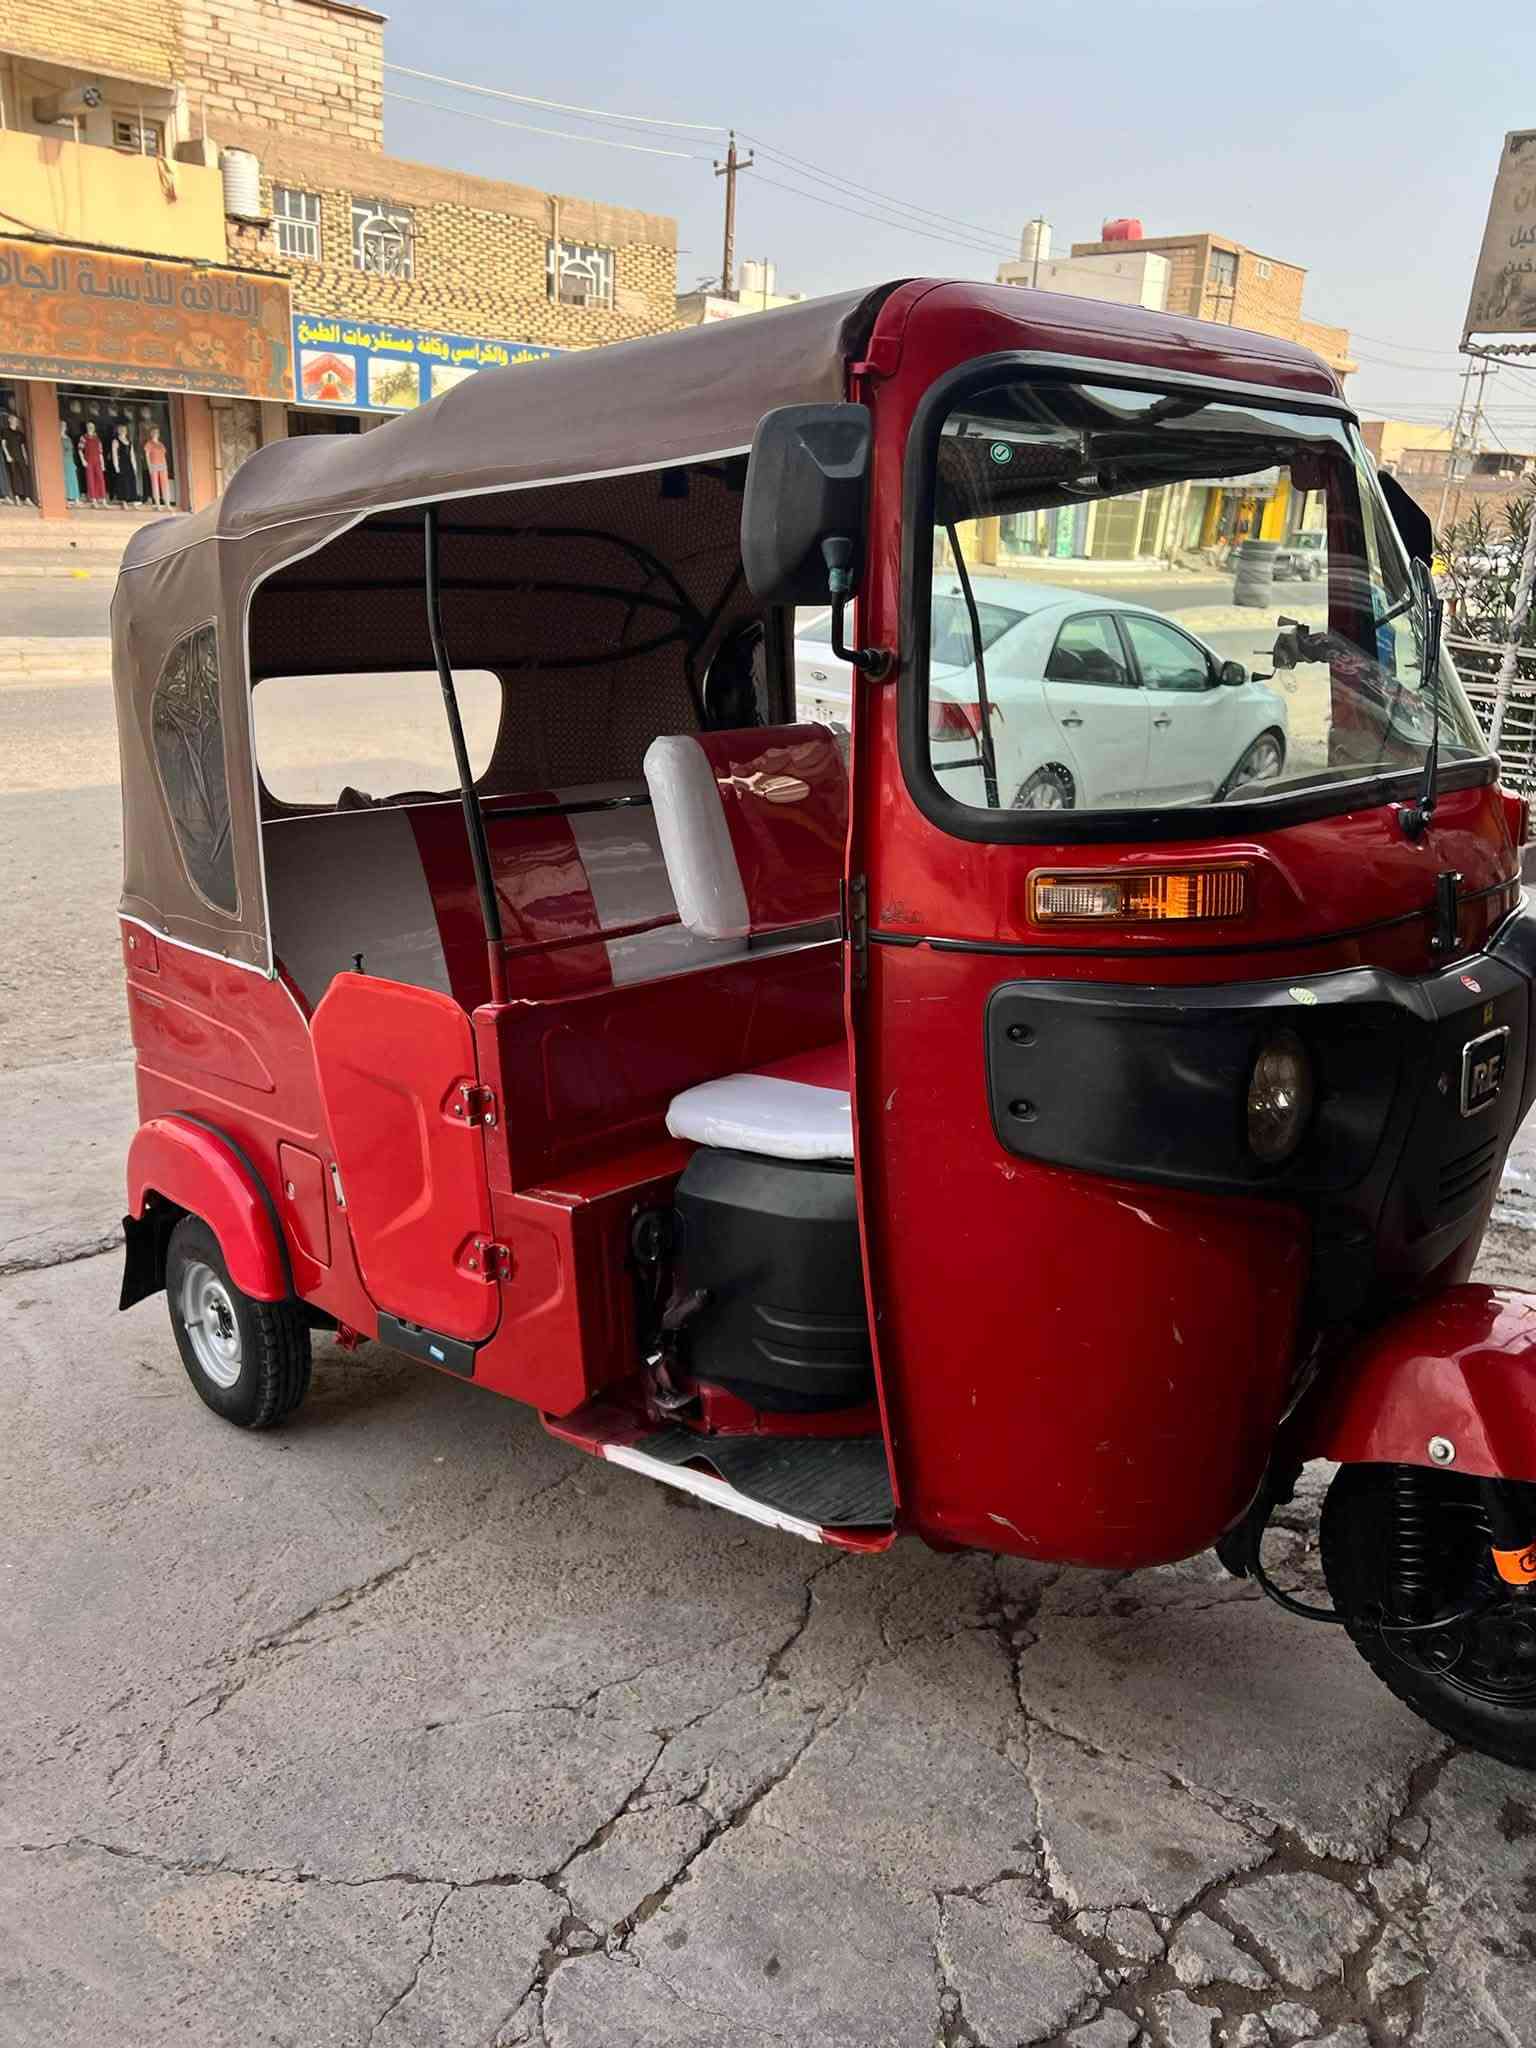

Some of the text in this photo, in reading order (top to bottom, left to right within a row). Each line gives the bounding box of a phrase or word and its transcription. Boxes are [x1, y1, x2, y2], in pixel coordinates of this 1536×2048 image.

[0, 250, 68, 298] الجاه
[181, 271, 261, 317] الأناقة
[297, 320, 340, 344] الطبخ
[342, 327, 415, 353] مستلزمات
[450, 342, 509, 366] والكراسي
